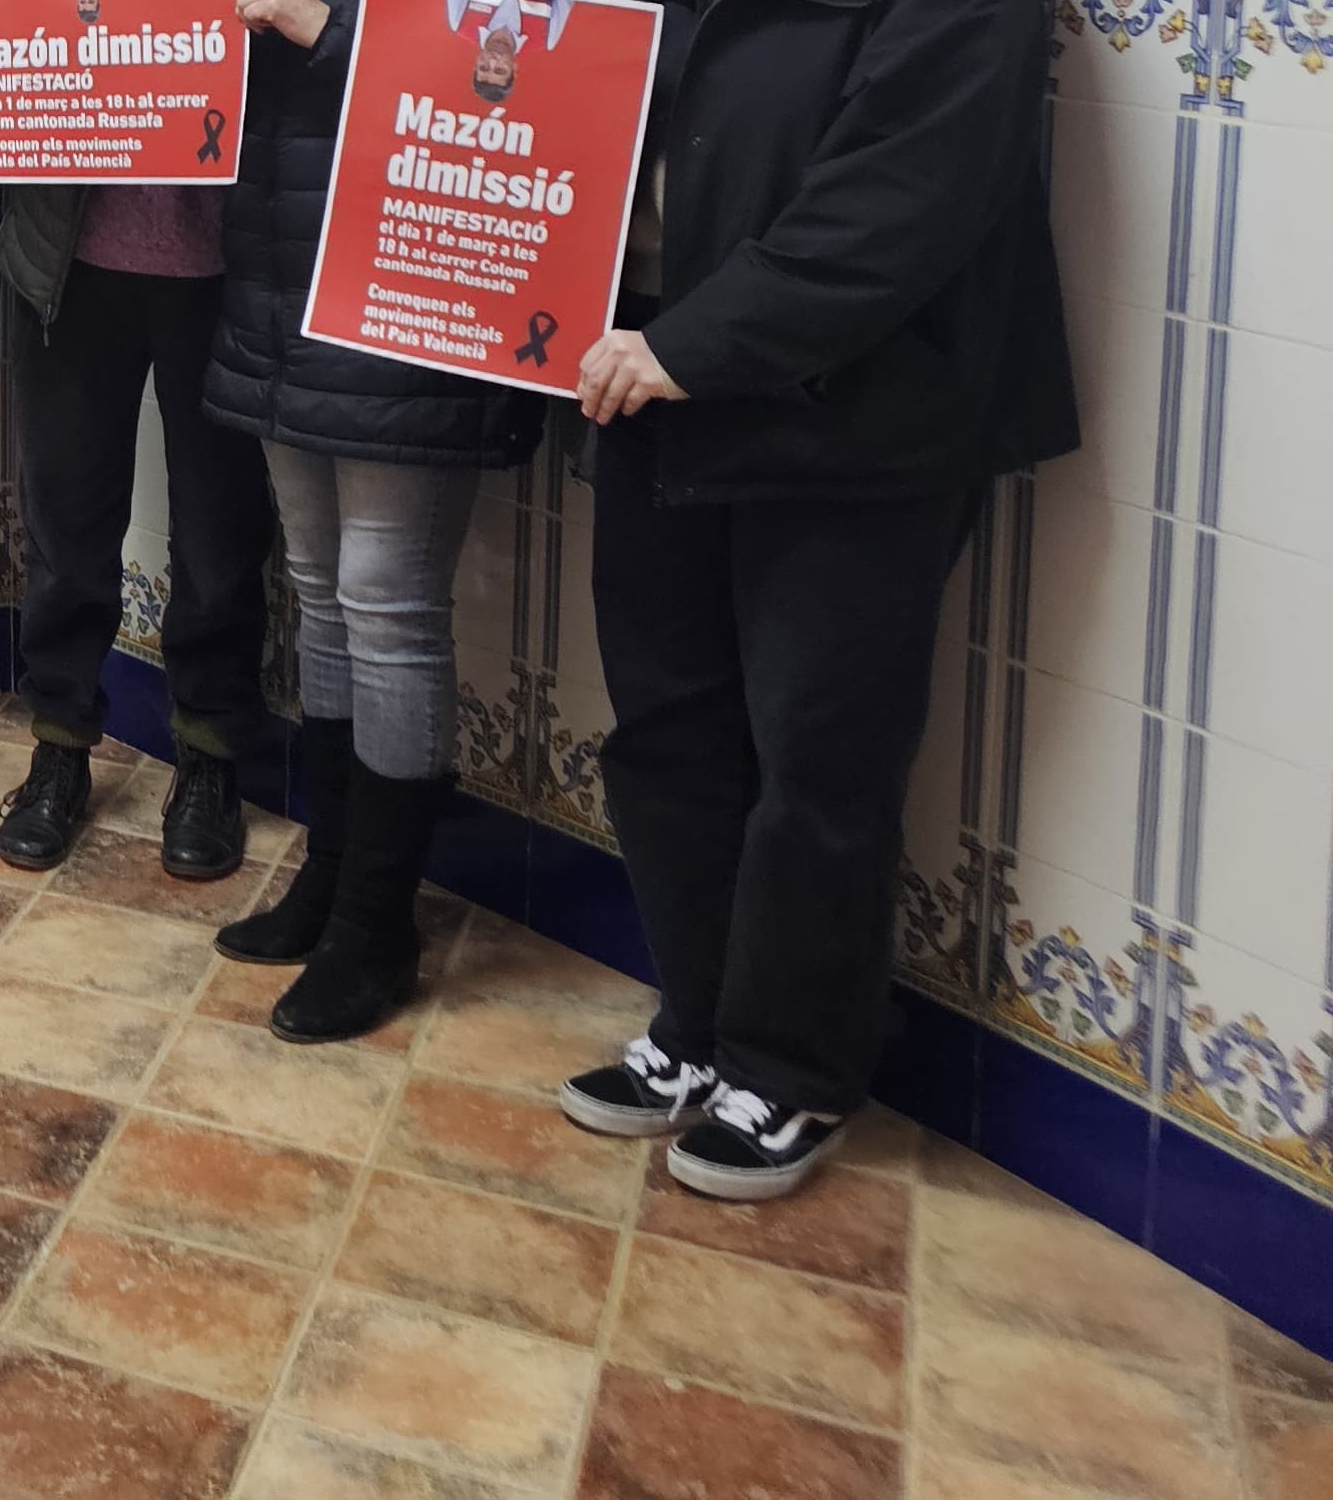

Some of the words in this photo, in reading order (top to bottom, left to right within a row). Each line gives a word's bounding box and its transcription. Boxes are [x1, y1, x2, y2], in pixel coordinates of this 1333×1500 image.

[78, 20, 226, 66] dimissió
[6, 97, 12, 110] 1
[16, 96, 32, 110] de
[35, 99, 67, 111] març
[71, 99, 79, 109] a
[82, 95, 103, 109] les
[106, 94, 123, 108] 18
[125, 94, 135, 108] h
[138, 92, 153, 108] al
[157, 94, 209, 108] carrer
[17, 113, 95, 129] cantonada
[98, 112, 163, 128] Russafa
[395, 92, 534, 156] Mazón
[18, 154, 38, 167] del
[42, 153, 70, 167] País
[73, 153, 132, 167] Valencià
[42, 137, 63, 150] els
[66, 137, 142, 151] moviments
[387, 145, 574, 215] dimissió
[383, 196, 548, 244] MANIFESTACIÓ
[378, 237, 396, 254] 18
[399, 241, 408, 256] h
[412, 248, 426, 260] al
[430, 253, 476, 269] carrer
[480, 259, 529, 280] Colom
[379, 220, 394, 235] el
[398, 222, 420, 239] dia
[426, 227, 432, 241] 1
[437, 230, 455, 246] de
[459, 237, 497, 256] març
[500, 245, 509, 256] a
[514, 244, 537, 262] les
[374, 257, 450, 281] cantonada
[453, 269, 515, 294] Russafa
[368, 283, 449, 312] Convoquen
[452, 301, 475, 318] els
[360, 320, 385, 339] del
[387, 325, 419, 346] País
[424, 332, 487, 360] Valencià
[364, 305, 446, 332] moviments
[449, 322, 503, 344] socials
